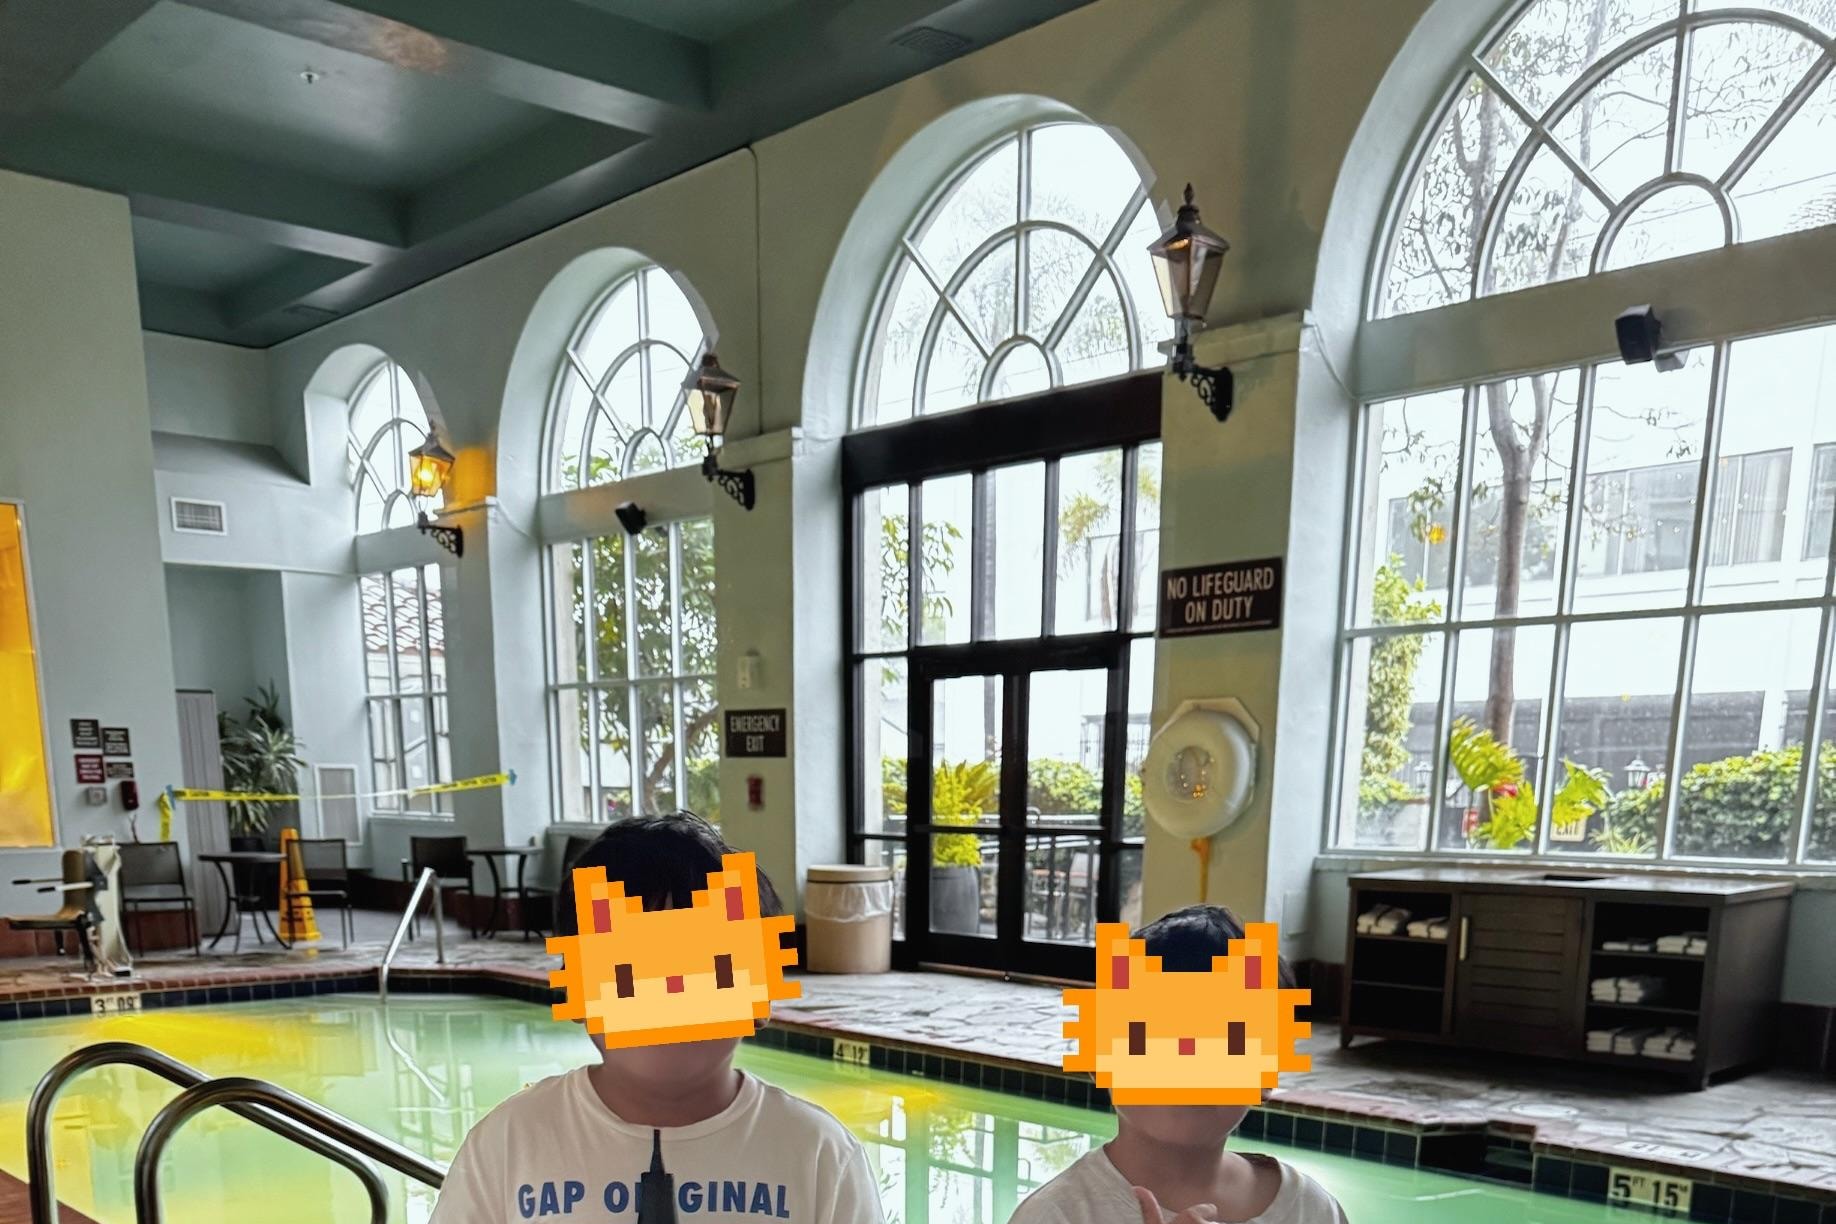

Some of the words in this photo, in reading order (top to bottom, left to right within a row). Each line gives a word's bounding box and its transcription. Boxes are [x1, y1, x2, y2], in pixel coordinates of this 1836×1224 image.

[1167, 577, 1187, 600] NO
[1193, 567, 1274, 597] LIFEGUARD
[1185, 601, 1207, 624] ON
[1212, 596, 1253, 621] DUTY
[731, 715, 780, 732] EMERGENCY
[746, 735, 764, 752] EXIT
[518, 1181, 585, 1219] GAP
[603, 1181, 790, 1218] OGINAL
